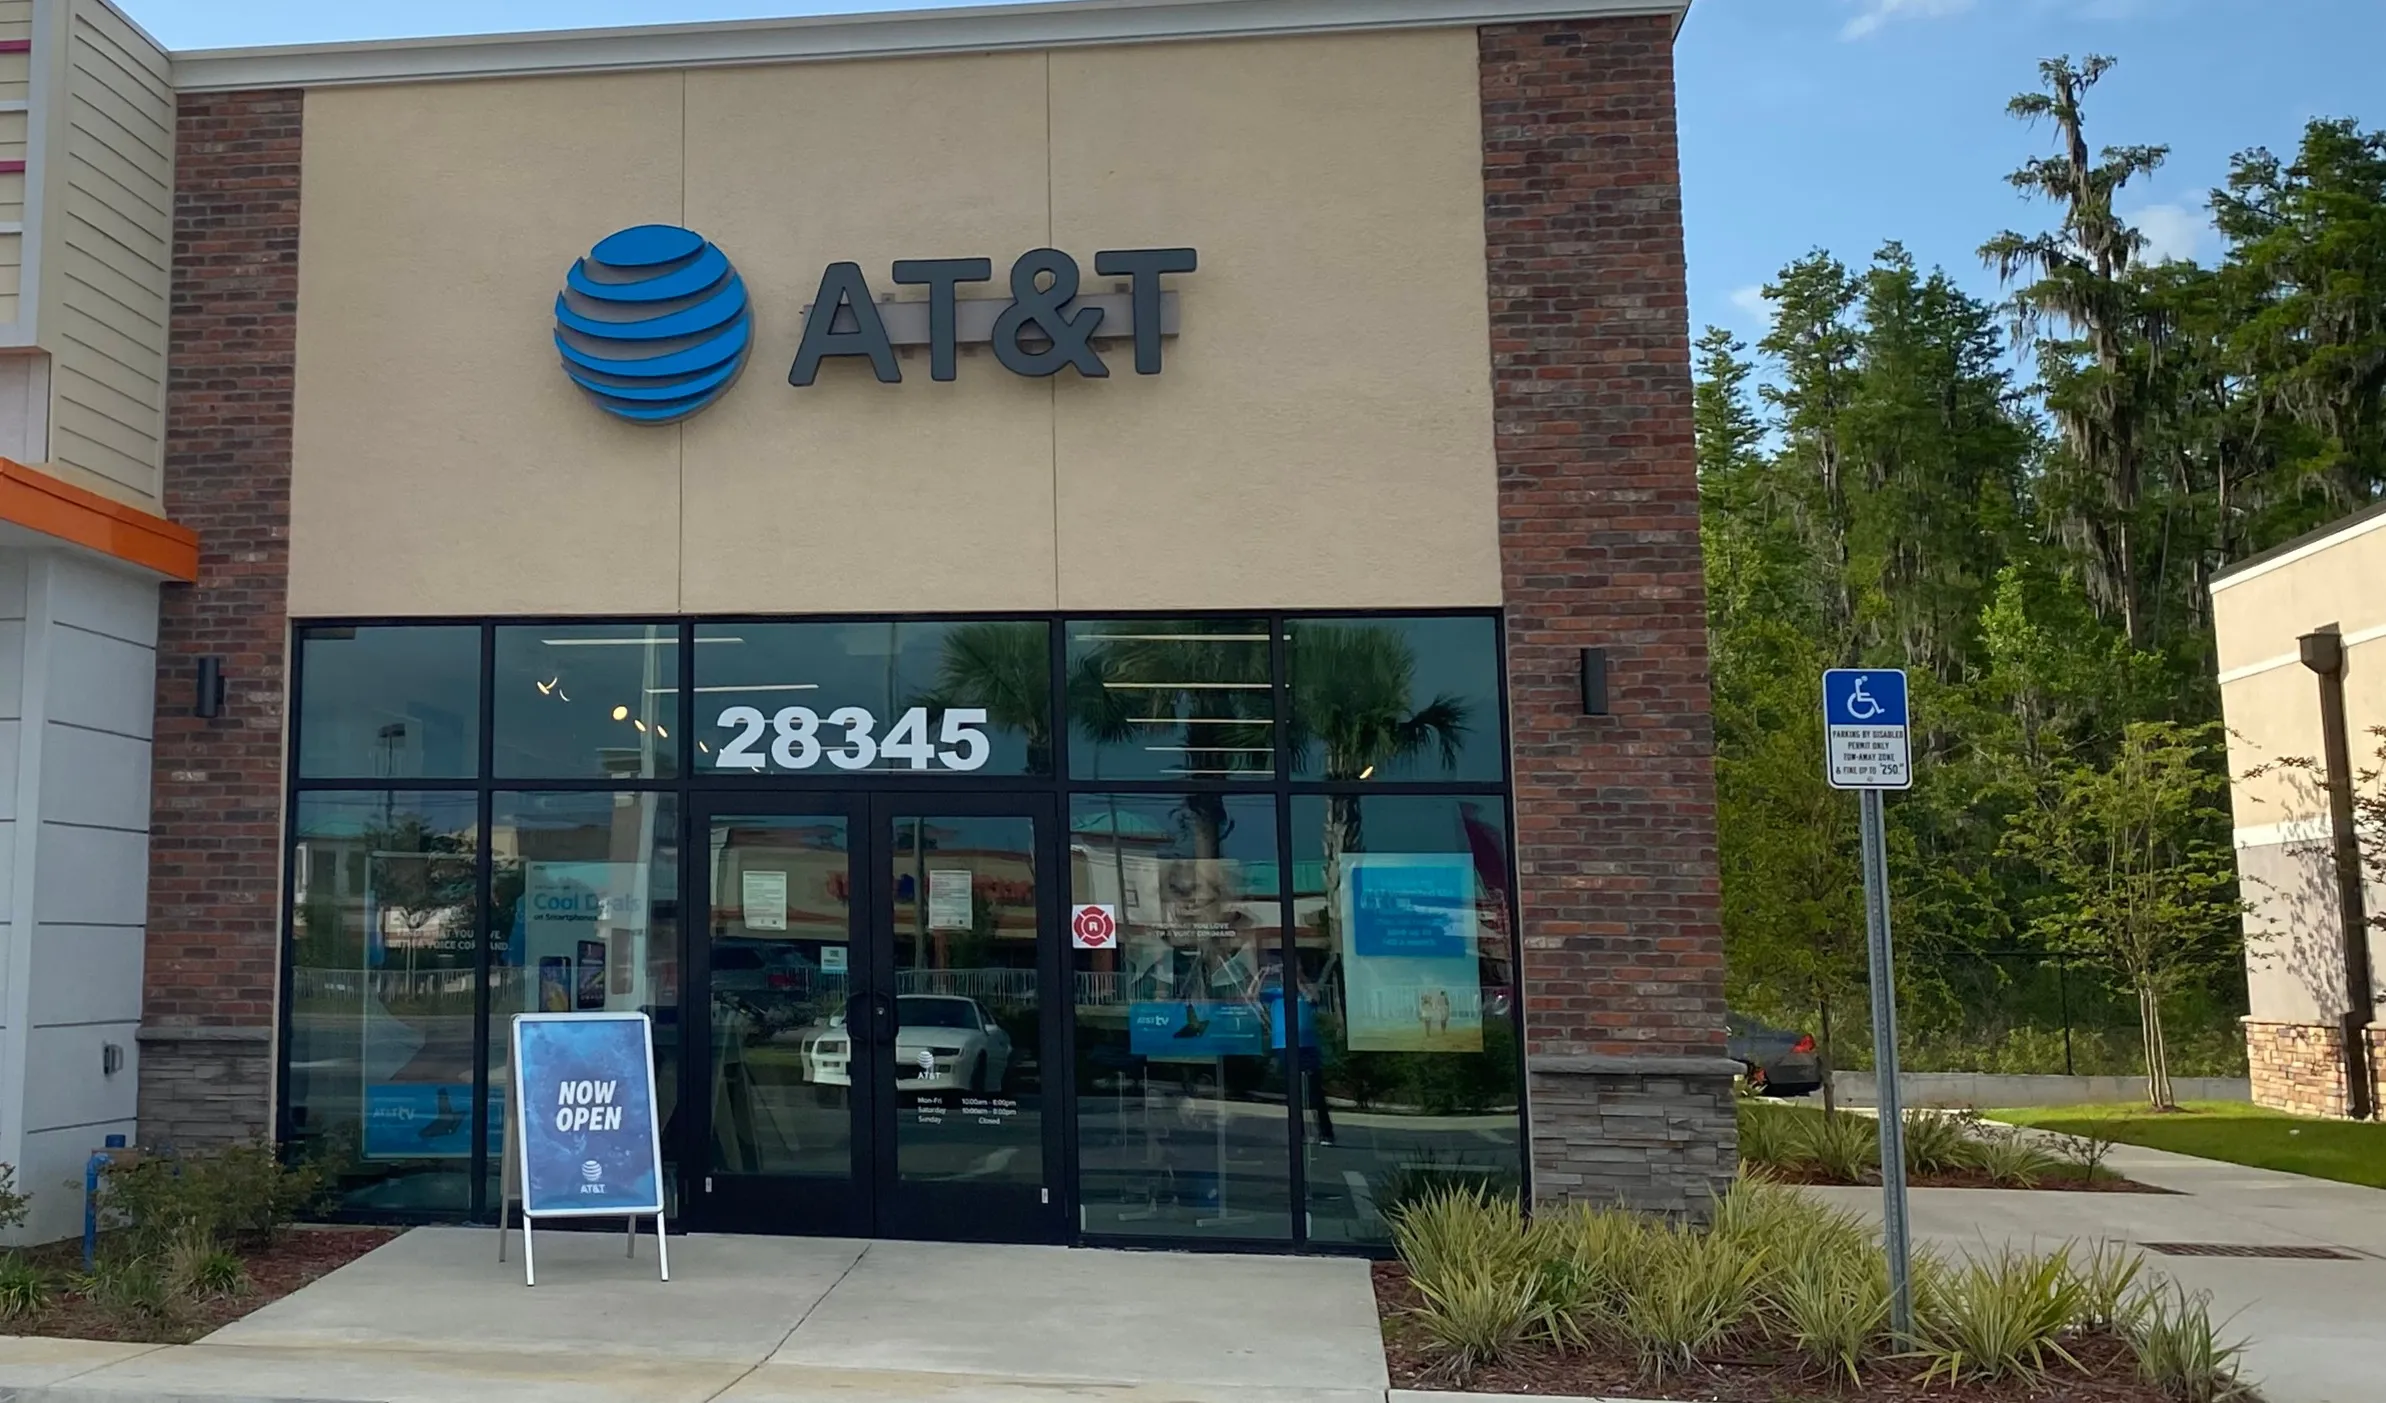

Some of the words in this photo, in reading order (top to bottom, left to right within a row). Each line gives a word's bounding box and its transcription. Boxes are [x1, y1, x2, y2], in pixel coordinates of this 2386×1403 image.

[788, 247, 1197, 387] AT&T
[715, 706, 990, 771] 28345
[1833, 730, 1860, 739] PARKING
[1862, 730, 1871, 739] BY
[1873, 730, 1903, 739] DISABLED
[1848, 742, 1871, 750] PERMIT
[1843, 753, 1876, 761] TOW-AWAY
[1878, 753, 1895, 761] ZONE
[1843, 766, 1857, 775] FINE
[1858, 766, 1868, 775] UP
[1869, 766, 1877, 775] TO
[533, 891, 578, 911] Cool
[585, 892, 641, 912] Dals
[545, 913, 598, 922] Smartphones
[454, 929, 475, 939] YOU
[428, 940, 456, 950] VOICE
[917, 1071, 942, 1080] AT&T
[558, 1080, 617, 1105] NOW
[918, 1107, 947, 1115] Saturday
[556, 1106, 622, 1132] OPEN
[918, 1116, 942, 1125] Sunday
[978, 1117, 1001, 1125] Closed
[580, 1184, 606, 1194] AT&T
